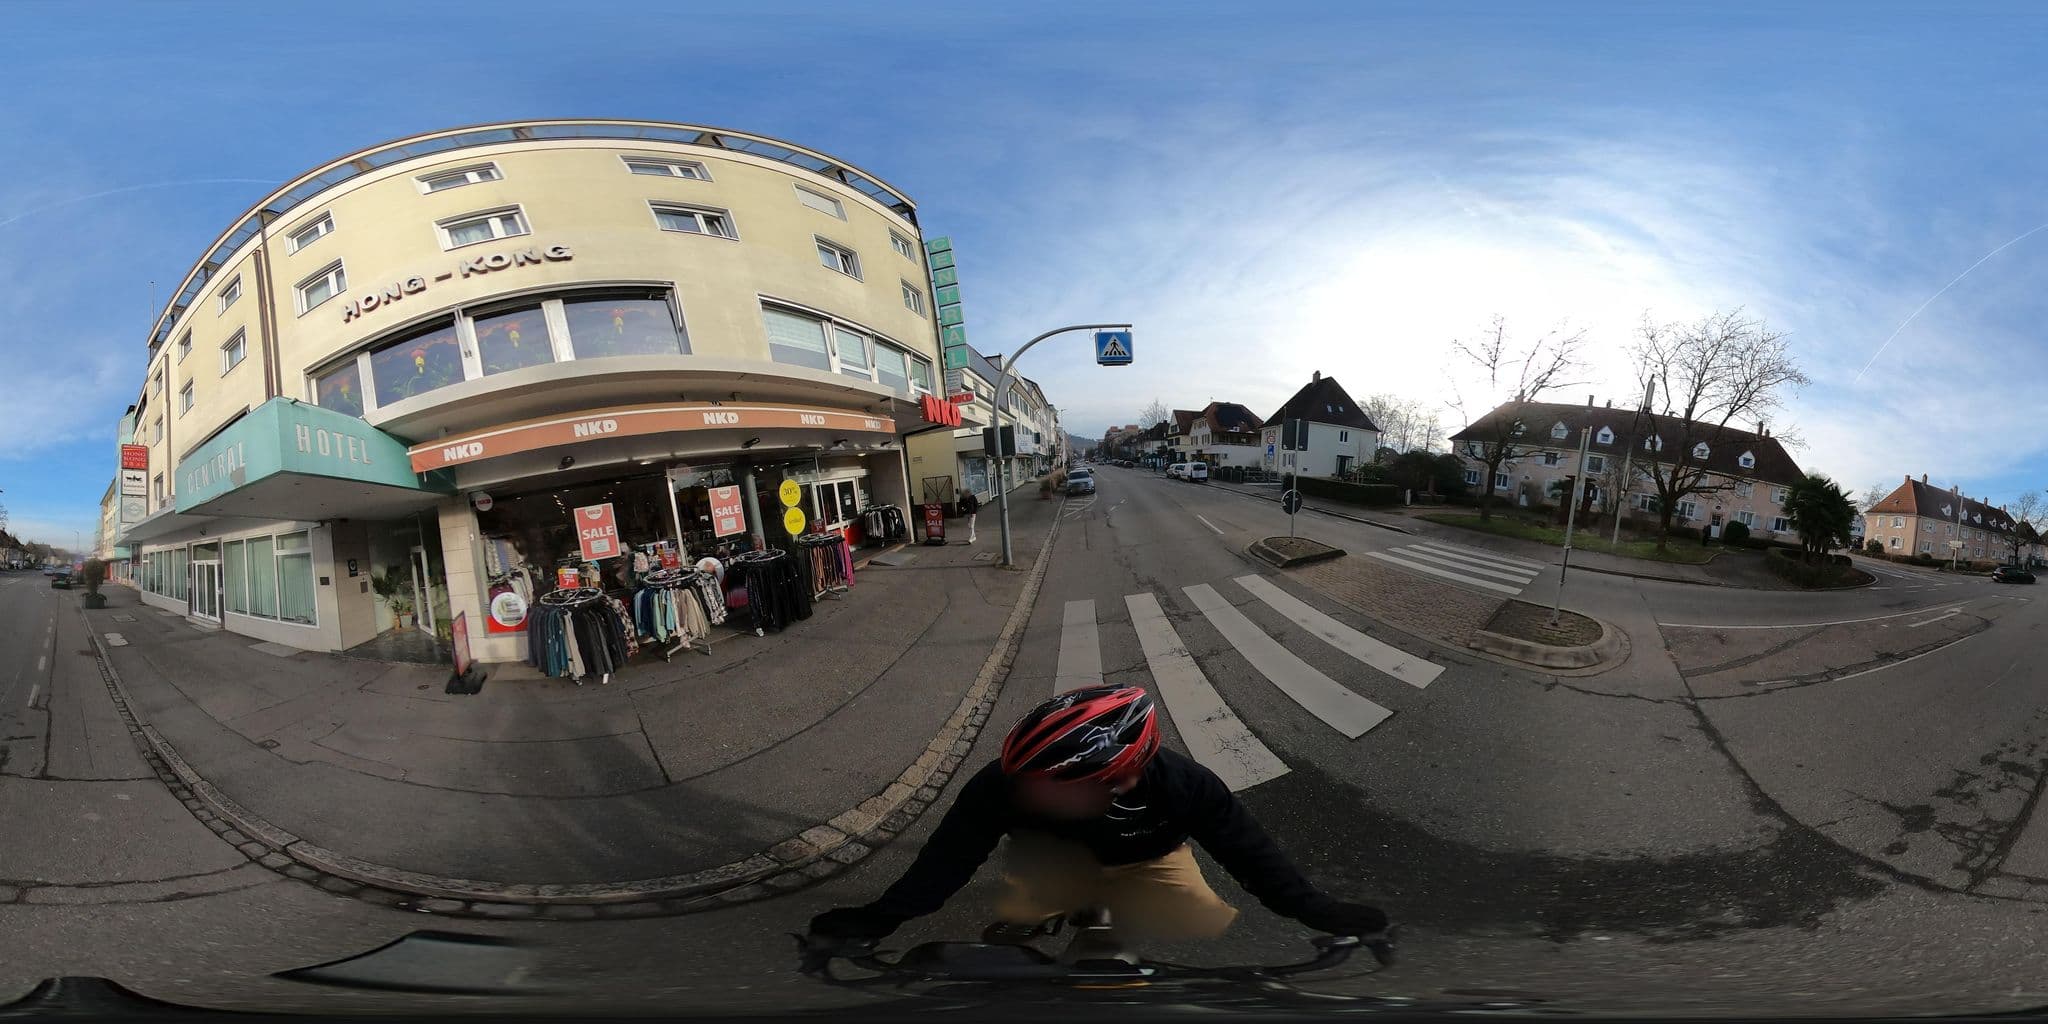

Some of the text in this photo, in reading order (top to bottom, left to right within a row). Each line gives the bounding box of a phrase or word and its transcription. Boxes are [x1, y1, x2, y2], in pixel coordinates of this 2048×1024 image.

[342, 274, 427, 323] HONG
[460, 243, 575, 278] KONG
[931, 239, 961, 366] CENTRAL
[703, 412, 739, 425] NKD
[801, 413, 826, 426] NKD
[922, 394, 962, 427] NKD
[573, 419, 618, 437] NKD
[864, 418, 882, 430] NKD
[296, 423, 373, 465] HOTEL
[443, 442, 484, 461] NKD
[187, 441, 246, 496] CENTRAL
[714, 504, 741, 518] SALE
[582, 525, 615, 540] SALE
